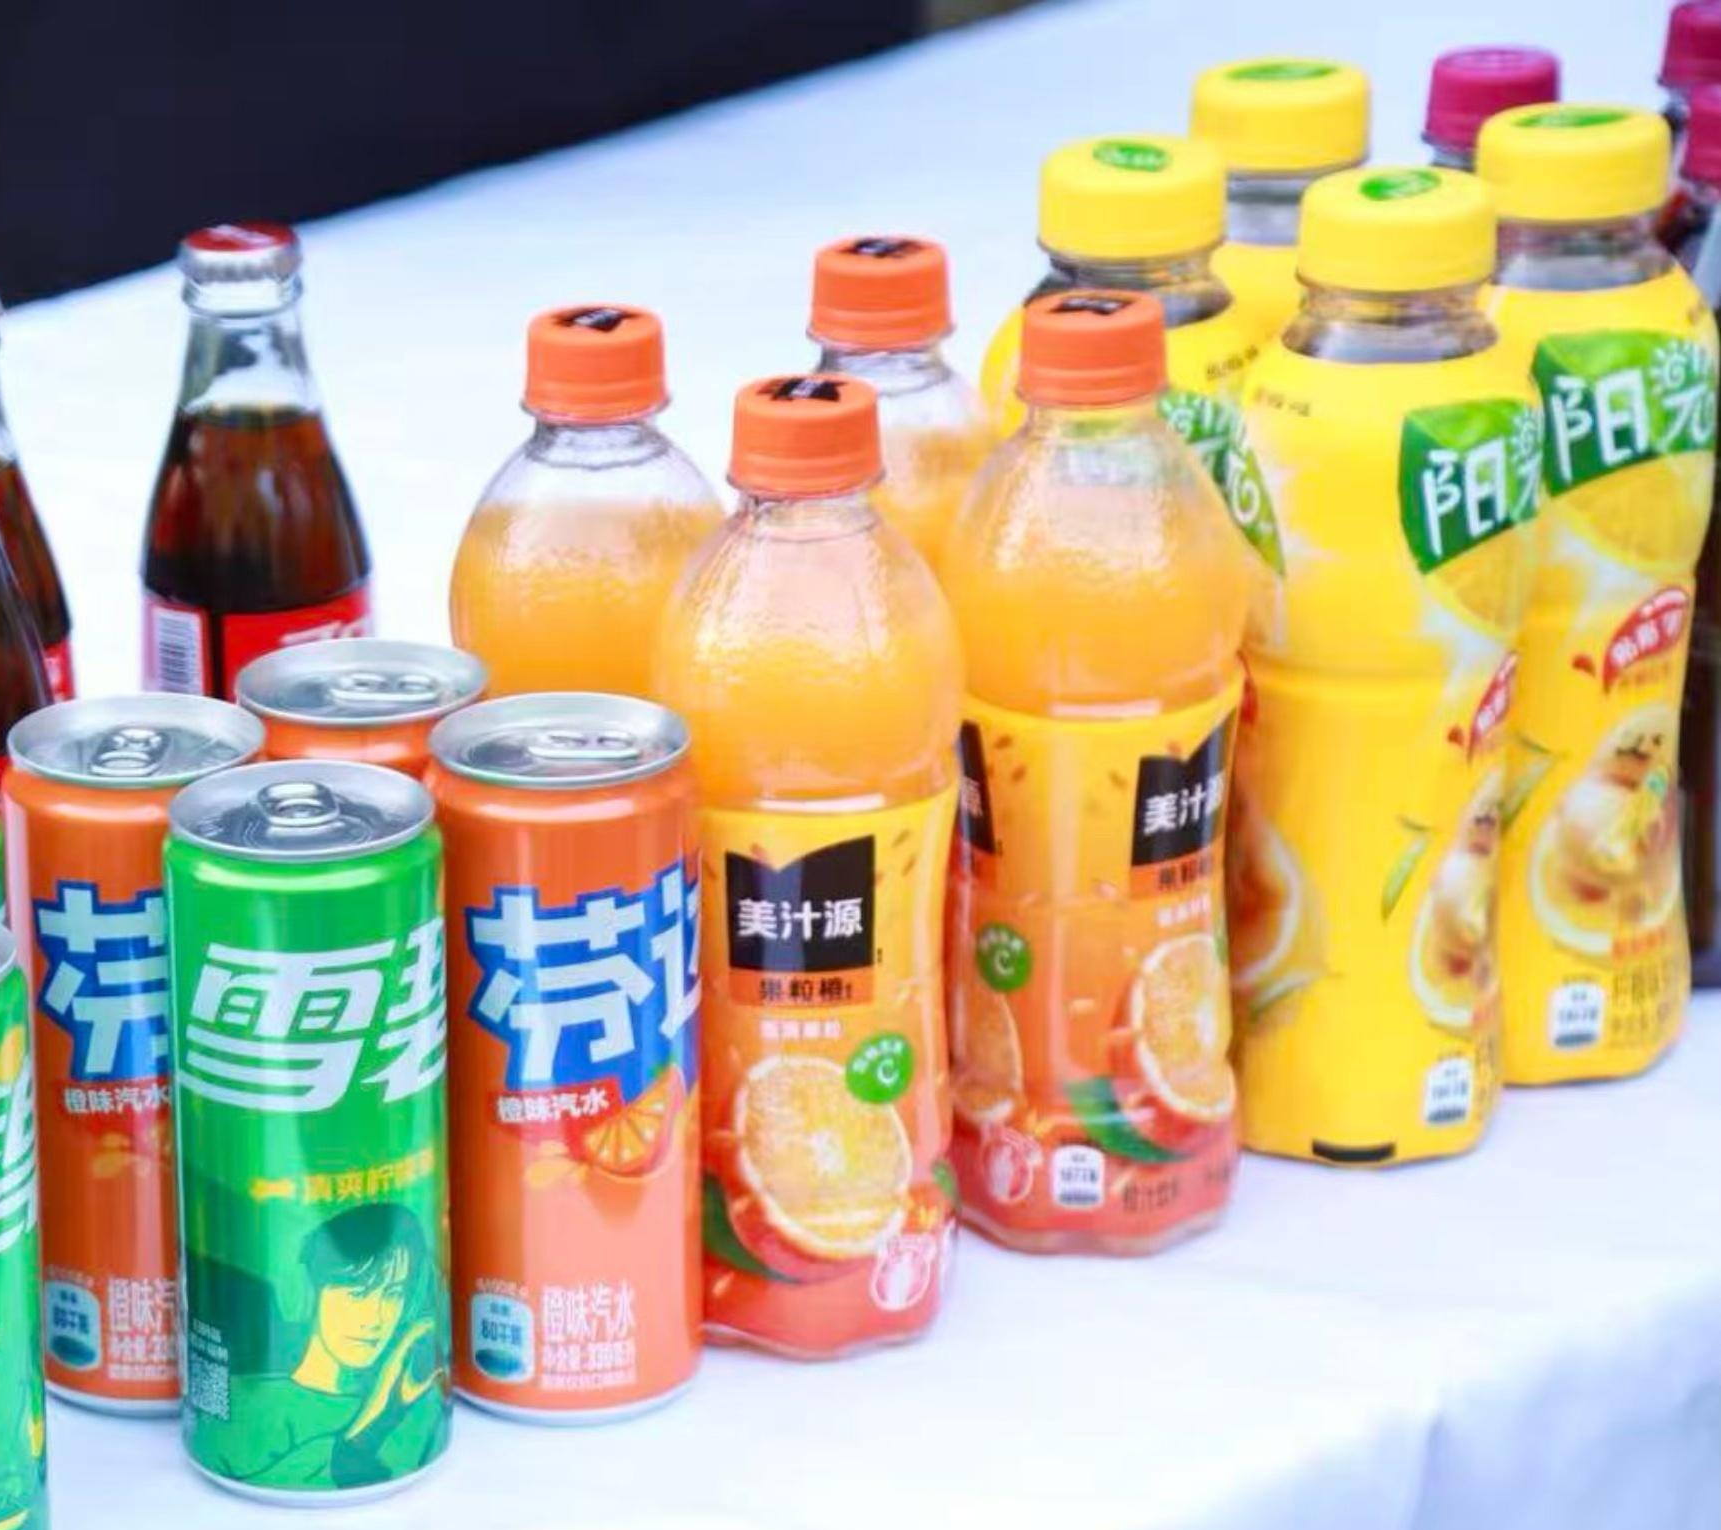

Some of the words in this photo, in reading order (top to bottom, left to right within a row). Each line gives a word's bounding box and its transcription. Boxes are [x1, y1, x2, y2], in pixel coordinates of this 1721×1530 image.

[737, 897, 863, 941] 美汁源
[497, 1085, 611, 1125] 橙味汽水
[541, 1280, 636, 1344] 橙味汽水
